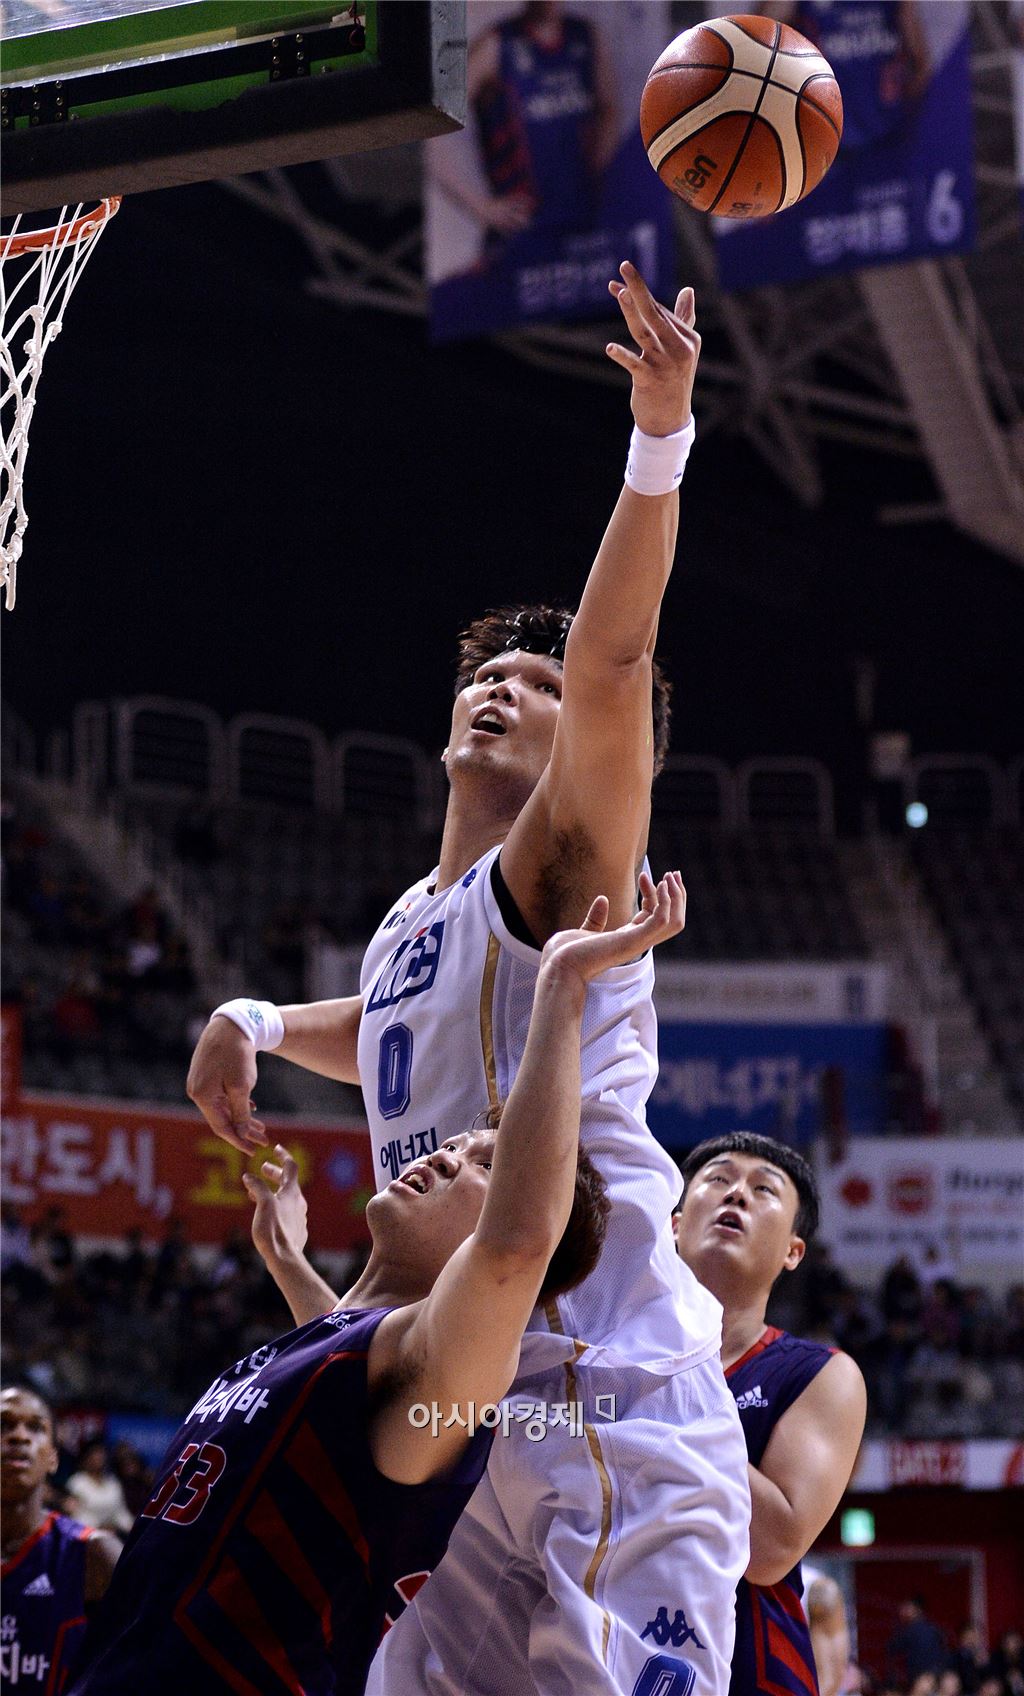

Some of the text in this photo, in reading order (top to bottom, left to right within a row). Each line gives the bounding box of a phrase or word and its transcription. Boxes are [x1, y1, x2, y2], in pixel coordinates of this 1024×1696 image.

[926, 169, 962, 244] 6
[632, 221, 656, 292] 1
[369, 926, 441, 1008] KCC
[378, 1022, 413, 1121] 0
[380, 1127, 438, 1181] 에너지
